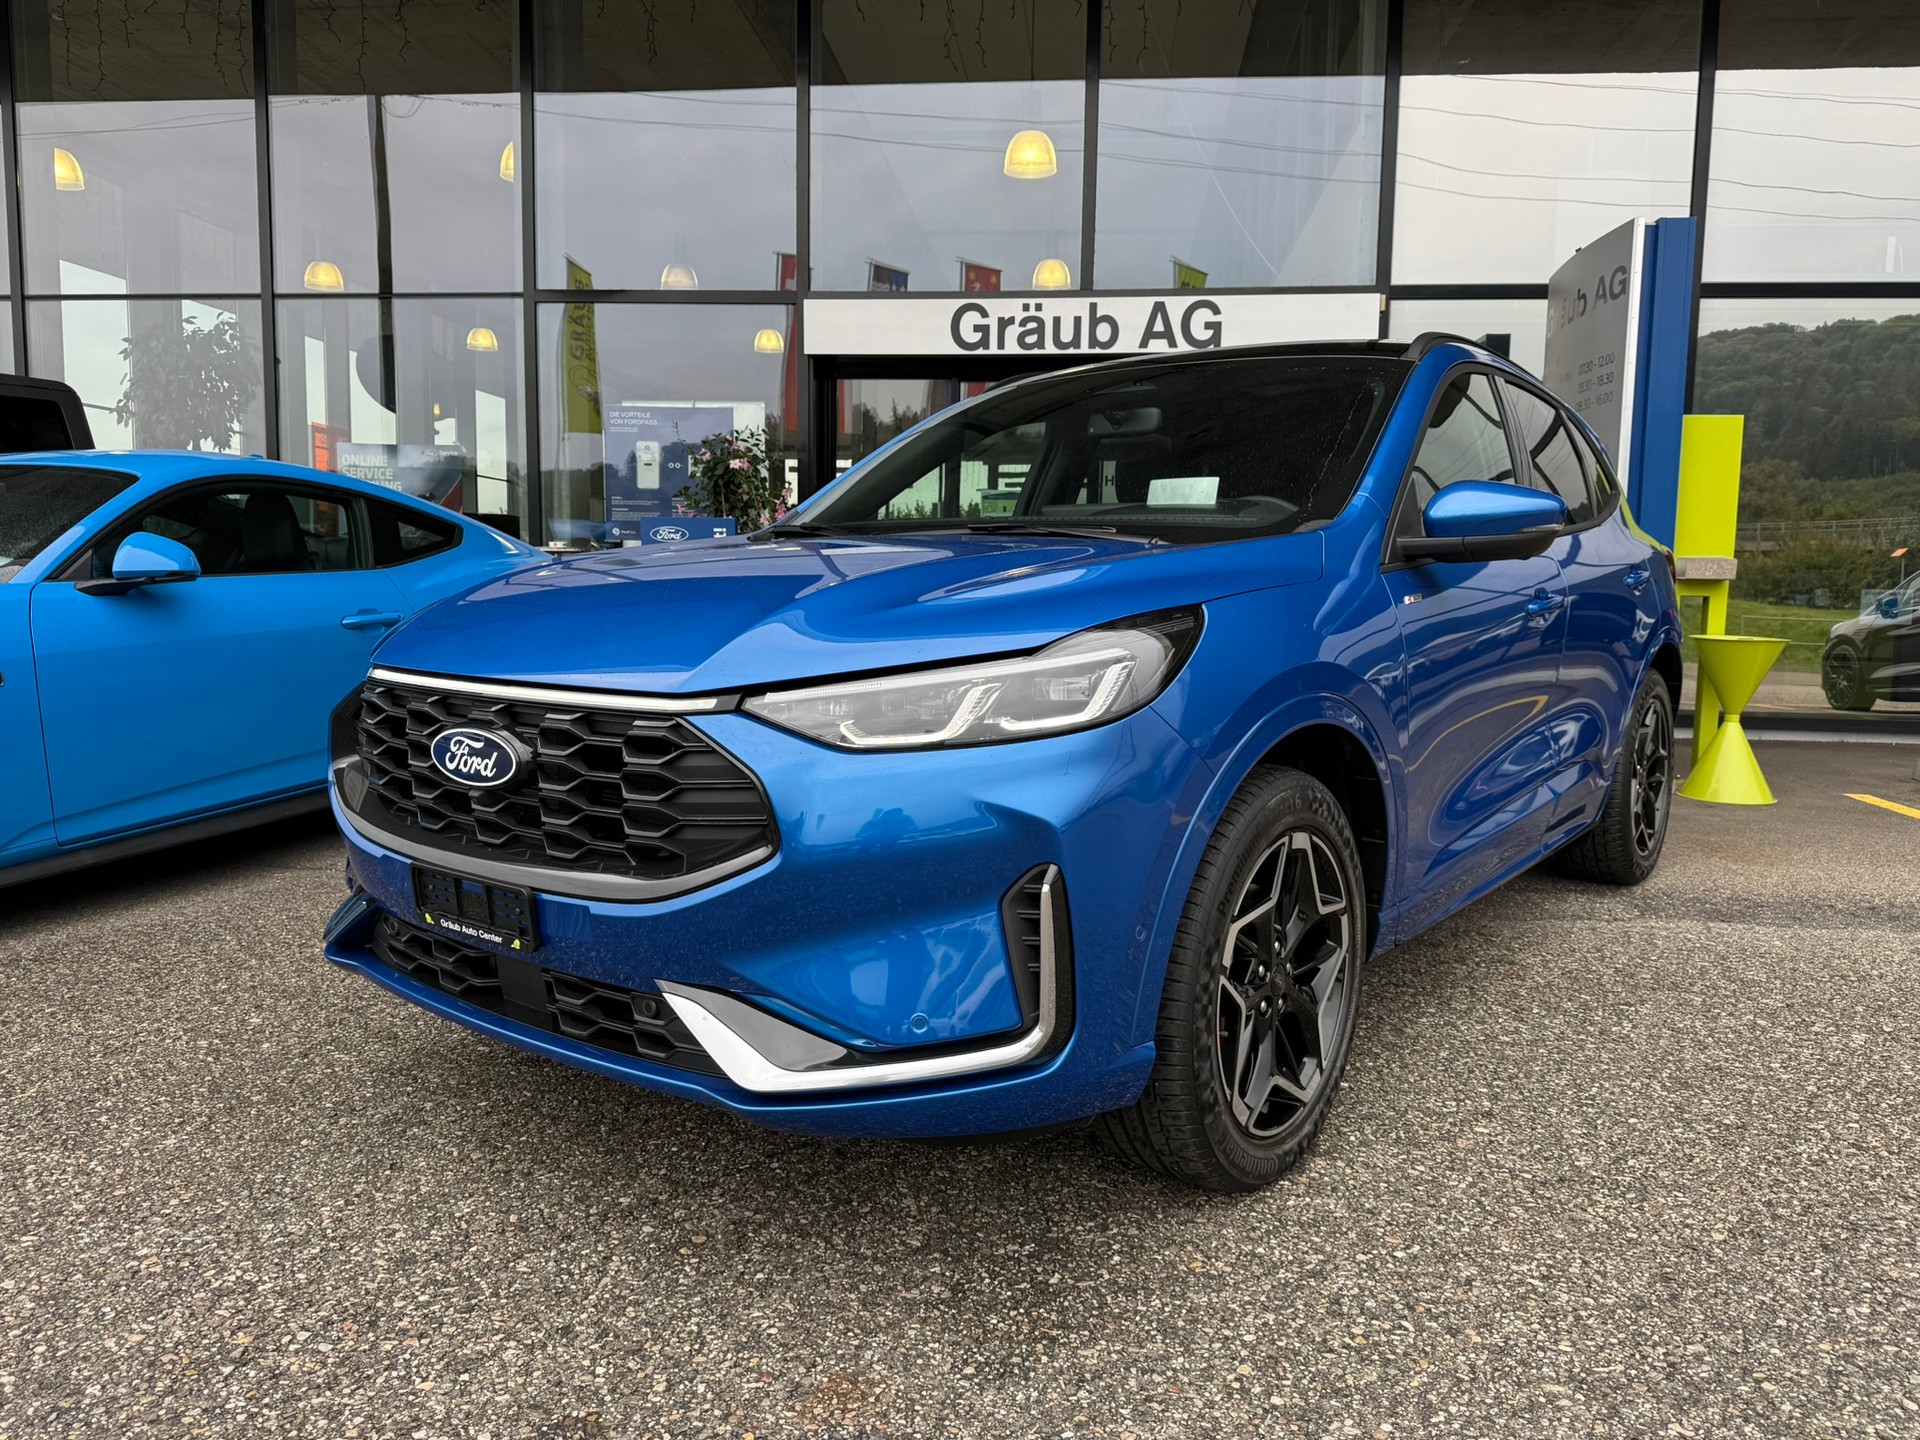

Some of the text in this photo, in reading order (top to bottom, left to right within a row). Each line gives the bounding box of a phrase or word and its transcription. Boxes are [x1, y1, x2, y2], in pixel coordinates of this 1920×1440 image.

[1593, 265, 1627, 311] AG
[950, 299, 1222, 351] Gräub AG
[341, 454, 388, 467] ONLINE
[342, 467, 394, 480] SERVICE
[445, 736, 498, 778] Ford
[440, 918, 503, 944] Gräub Auto Center
